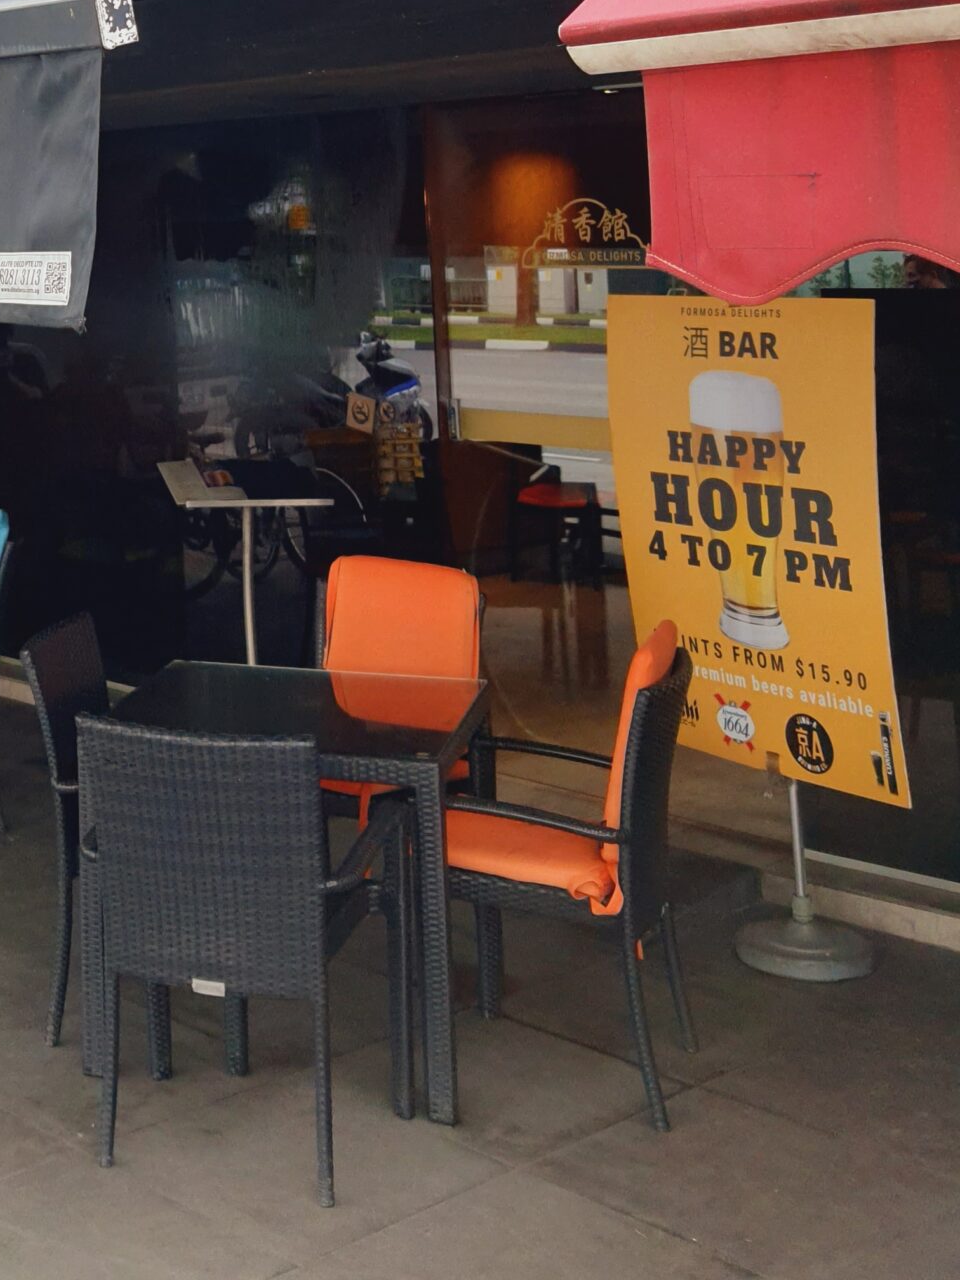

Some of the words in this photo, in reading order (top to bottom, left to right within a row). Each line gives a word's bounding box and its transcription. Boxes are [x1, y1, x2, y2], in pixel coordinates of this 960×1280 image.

[544, 206, 628, 244] 清香館
[589, 251, 641, 262] DELIGHTS
[680, 307, 726, 317] FORMOSA
[731, 308, 781, 319] DELIGHTS
[683, 326, 709, 359] 酒
[719, 330, 779, 360] BAR
[667, 430, 806, 474] HAPPY
[650, 471, 838, 547] HOUR
[649, 530, 668, 561] 4
[680, 534, 732, 571] TO
[746, 543, 767, 577] 7
[784, 549, 853, 592] PM
[681, 634, 723, 659] INTS
[733, 646, 785, 673] FROM
[795, 657, 868, 691] $15.90
[692, 664, 746, 689] remium
[752, 674, 794, 700] beers
[800, 690, 875, 718] avaliable
[723, 716, 750, 738] 1664
